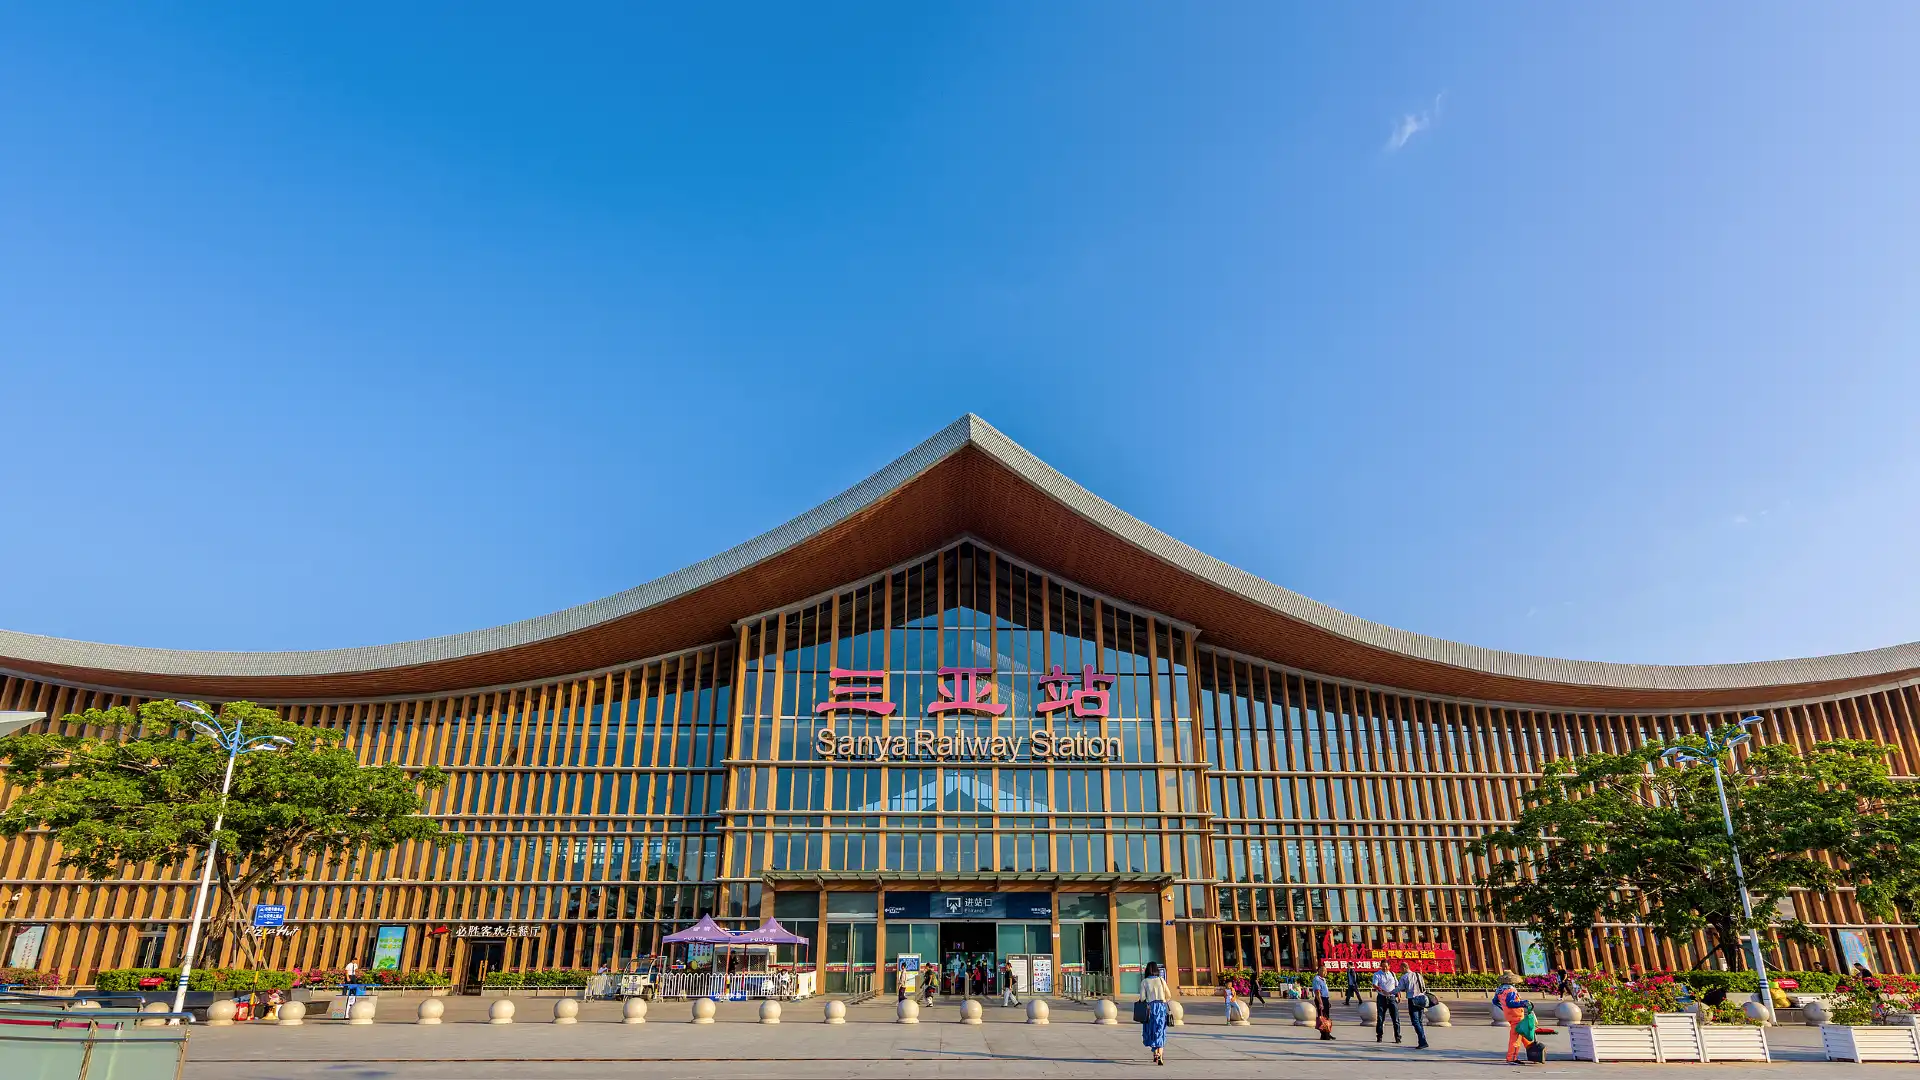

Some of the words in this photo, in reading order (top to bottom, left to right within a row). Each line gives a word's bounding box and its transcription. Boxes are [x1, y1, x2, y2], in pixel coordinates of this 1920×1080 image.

[816, 663, 1116, 717] 三亚站
[816, 727, 909, 761] Sanya
[914, 729, 1023, 761] Railway
[1031, 729, 1122, 757] Station
[964, 897, 993, 907] 进站口
[244, 925, 276, 937] Piza
[276, 925, 300, 936] Hut
[455, 925, 541, 937] 必胜客欢乐餐厅
[1371, 950, 1387, 959] 自由
[1388, 950, 1403, 959] 平等
[1404, 950, 1419, 959] 公正
[1420, 950, 1436, 959] 法治
[1323, 960, 1339, 969] 富强
[1356, 960, 1371, 969] 文明
